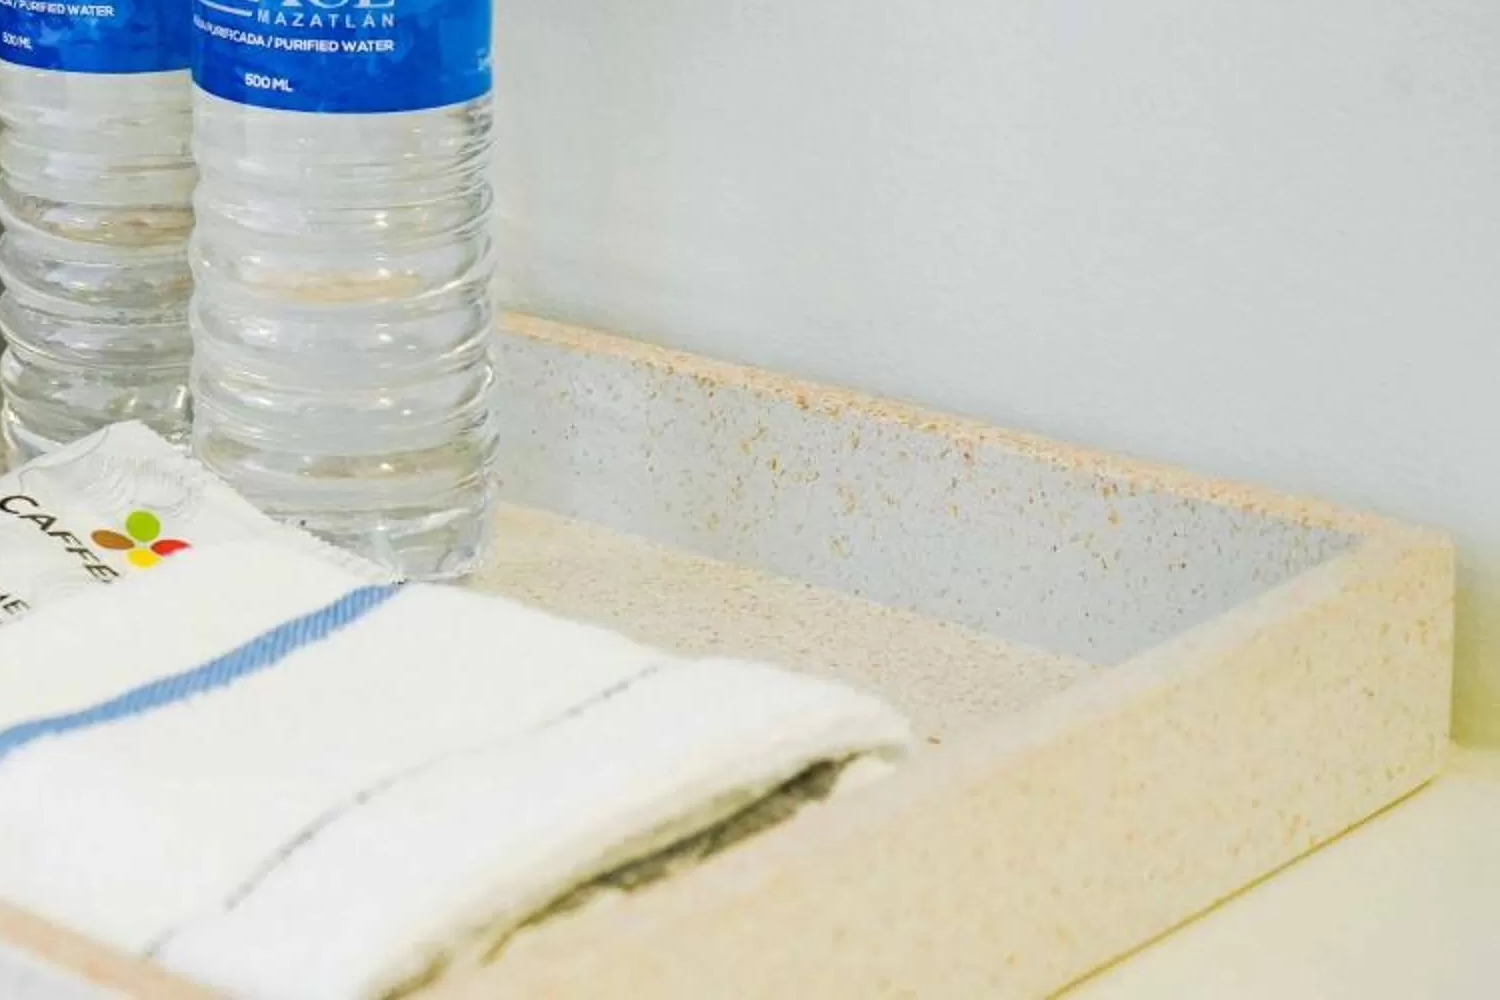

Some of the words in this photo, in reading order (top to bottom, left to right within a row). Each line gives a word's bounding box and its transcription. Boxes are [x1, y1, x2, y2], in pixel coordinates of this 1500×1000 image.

[67, 4, 114, 18] WATER
[257, 8, 395, 30] MAZATLÁN
[274, 37, 339, 53] PURIFIED
[342, 39, 394, 53] WATER
[244, 72, 271, 88] 500
[272, 77, 294, 92] ML
